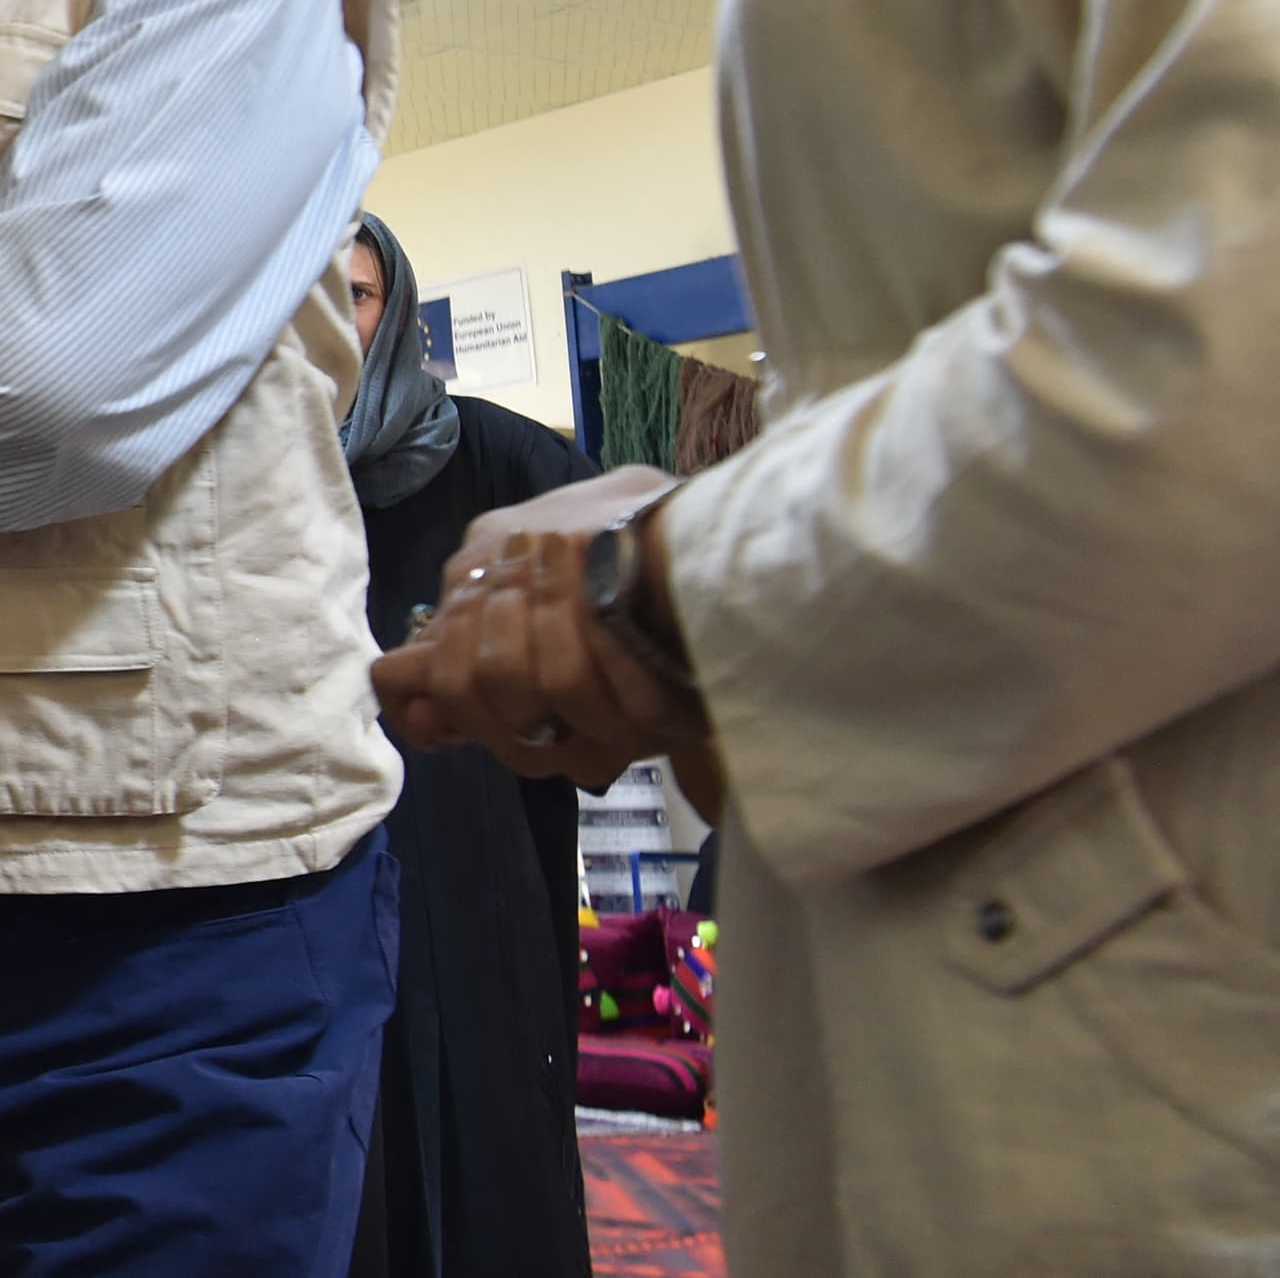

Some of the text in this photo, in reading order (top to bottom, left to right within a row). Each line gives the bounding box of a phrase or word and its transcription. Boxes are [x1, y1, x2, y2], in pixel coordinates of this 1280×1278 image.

[453, 310, 496, 326] Funded by
[454, 320, 522, 340] European Union
[455, 332, 528, 354] Humanitarian Aid
